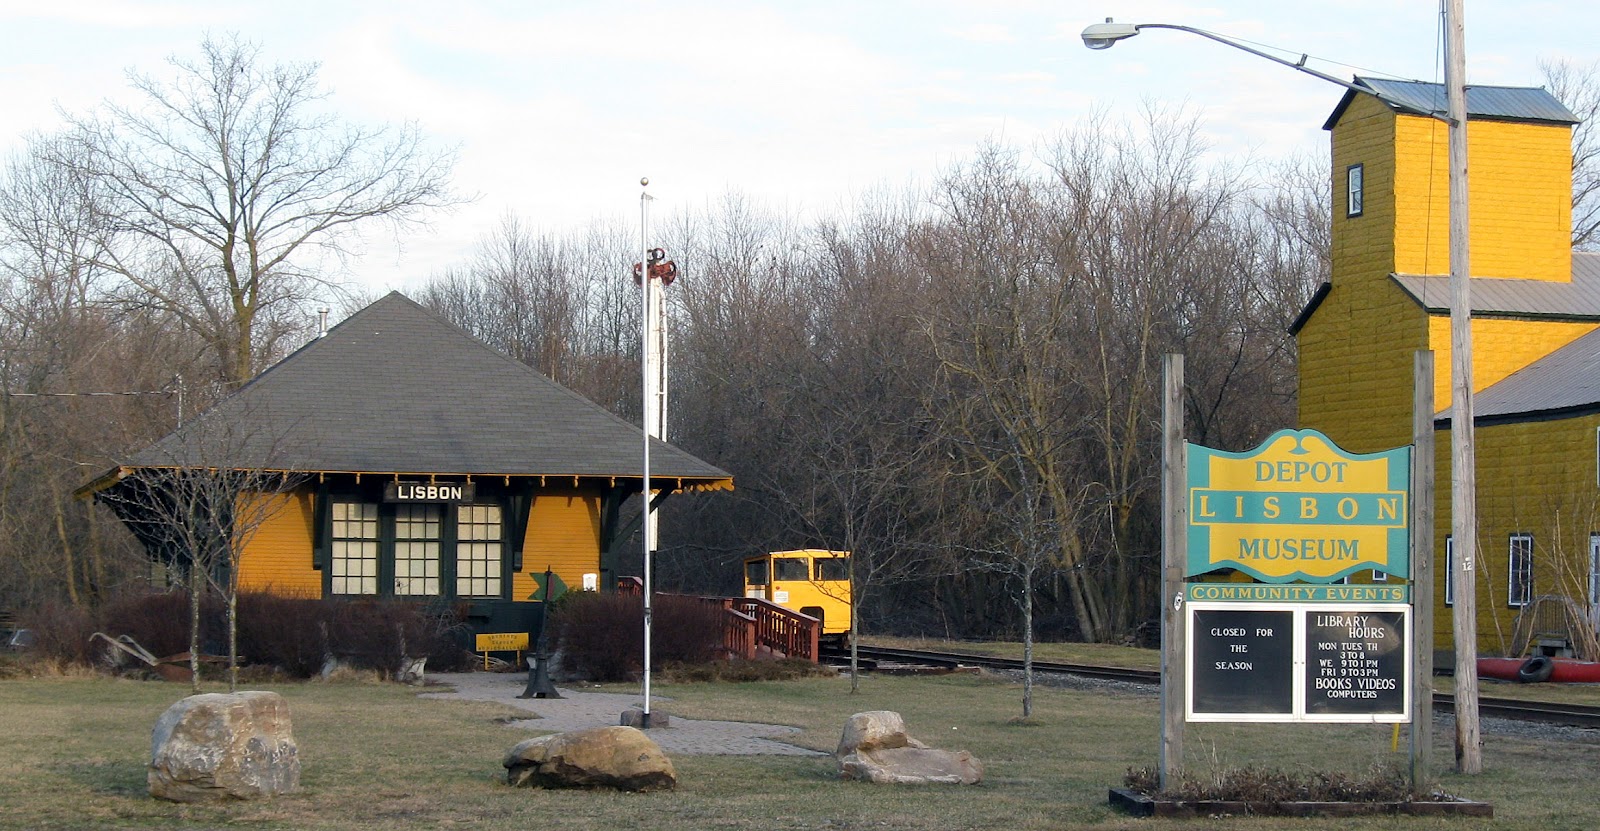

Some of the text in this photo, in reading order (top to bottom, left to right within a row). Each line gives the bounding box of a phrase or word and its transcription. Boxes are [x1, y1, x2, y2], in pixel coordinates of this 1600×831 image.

[1255, 460, 1348, 483] DEPOT
[397, 485, 462, 500] LISBON
[1199, 495, 1398, 520] LISBON
[1238, 538, 1359, 561] MUSEUM
[1462, 561, 1473, 571] 12
[1192, 586, 1403, 601] COMMUNITY EVENTS
[1317, 615, 1369, 627] LIBRARY
[1210, 628, 1273, 637] CLOSED FOR
[1348, 627, 1385, 639] HOURS
[1230, 644, 1248, 653] THE
[1318, 642, 1378, 651] MON TUES TH
[1340, 651, 1365, 660] 3 TO 8
[1215, 661, 1253, 671] SEASON
[1319, 659, 1333, 668] WE
[1366, 660, 1379, 668] PM
[1321, 668, 1336, 677] FRI
[1366, 668, 1379, 677] PM
[1315, 678, 1396, 690] BOOKS VIDEOS
[1327, 690, 1378, 699] COMPUTERS
